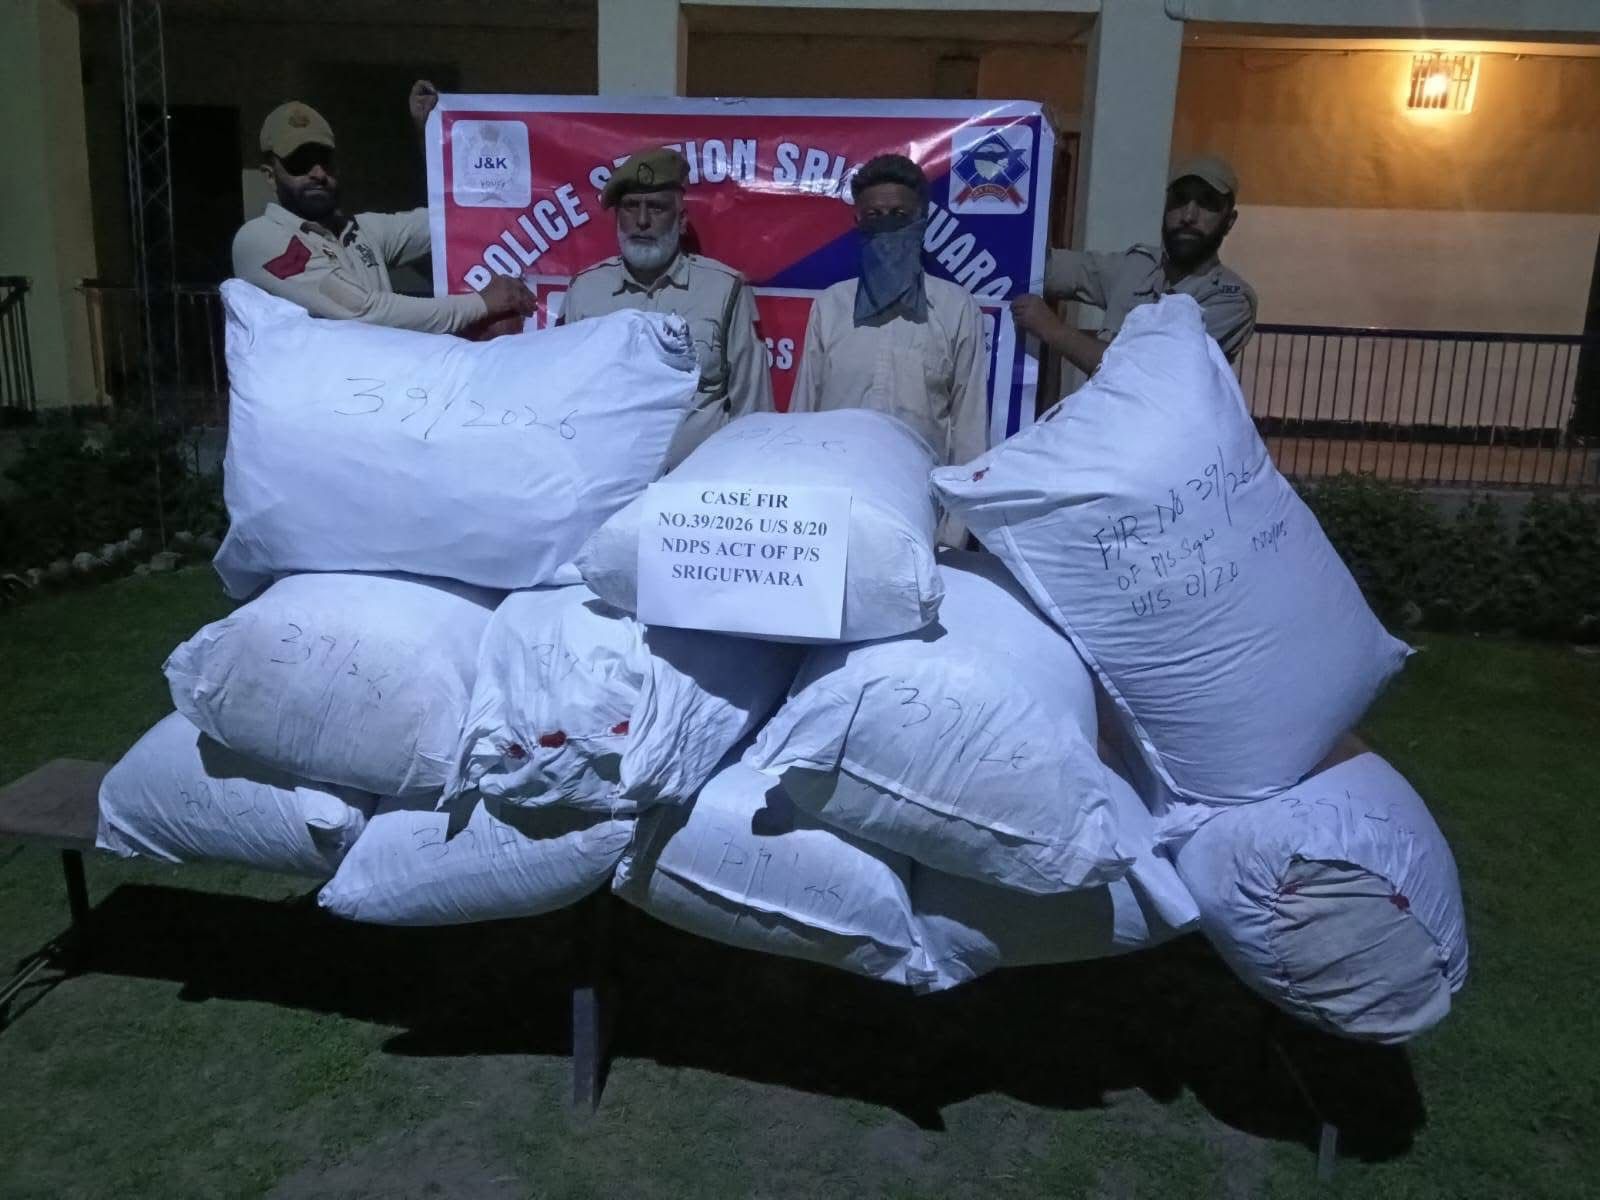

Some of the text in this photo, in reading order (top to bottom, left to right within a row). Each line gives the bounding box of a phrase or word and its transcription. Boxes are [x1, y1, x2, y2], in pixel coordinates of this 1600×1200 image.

[474, 157, 508, 169] J&K
[463, 182, 590, 292] POLICE
[333, 377, 578, 440] 39/2026
[701, 490, 789, 509] CASE FIR
[658, 512, 828, 537] NO.39/2026 U/S 8/20
[661, 537, 821, 563] NDPS ACT OF P/S
[671, 564, 805, 588] SRIGUFWARA
[1132, 589, 1172, 617] U/S
